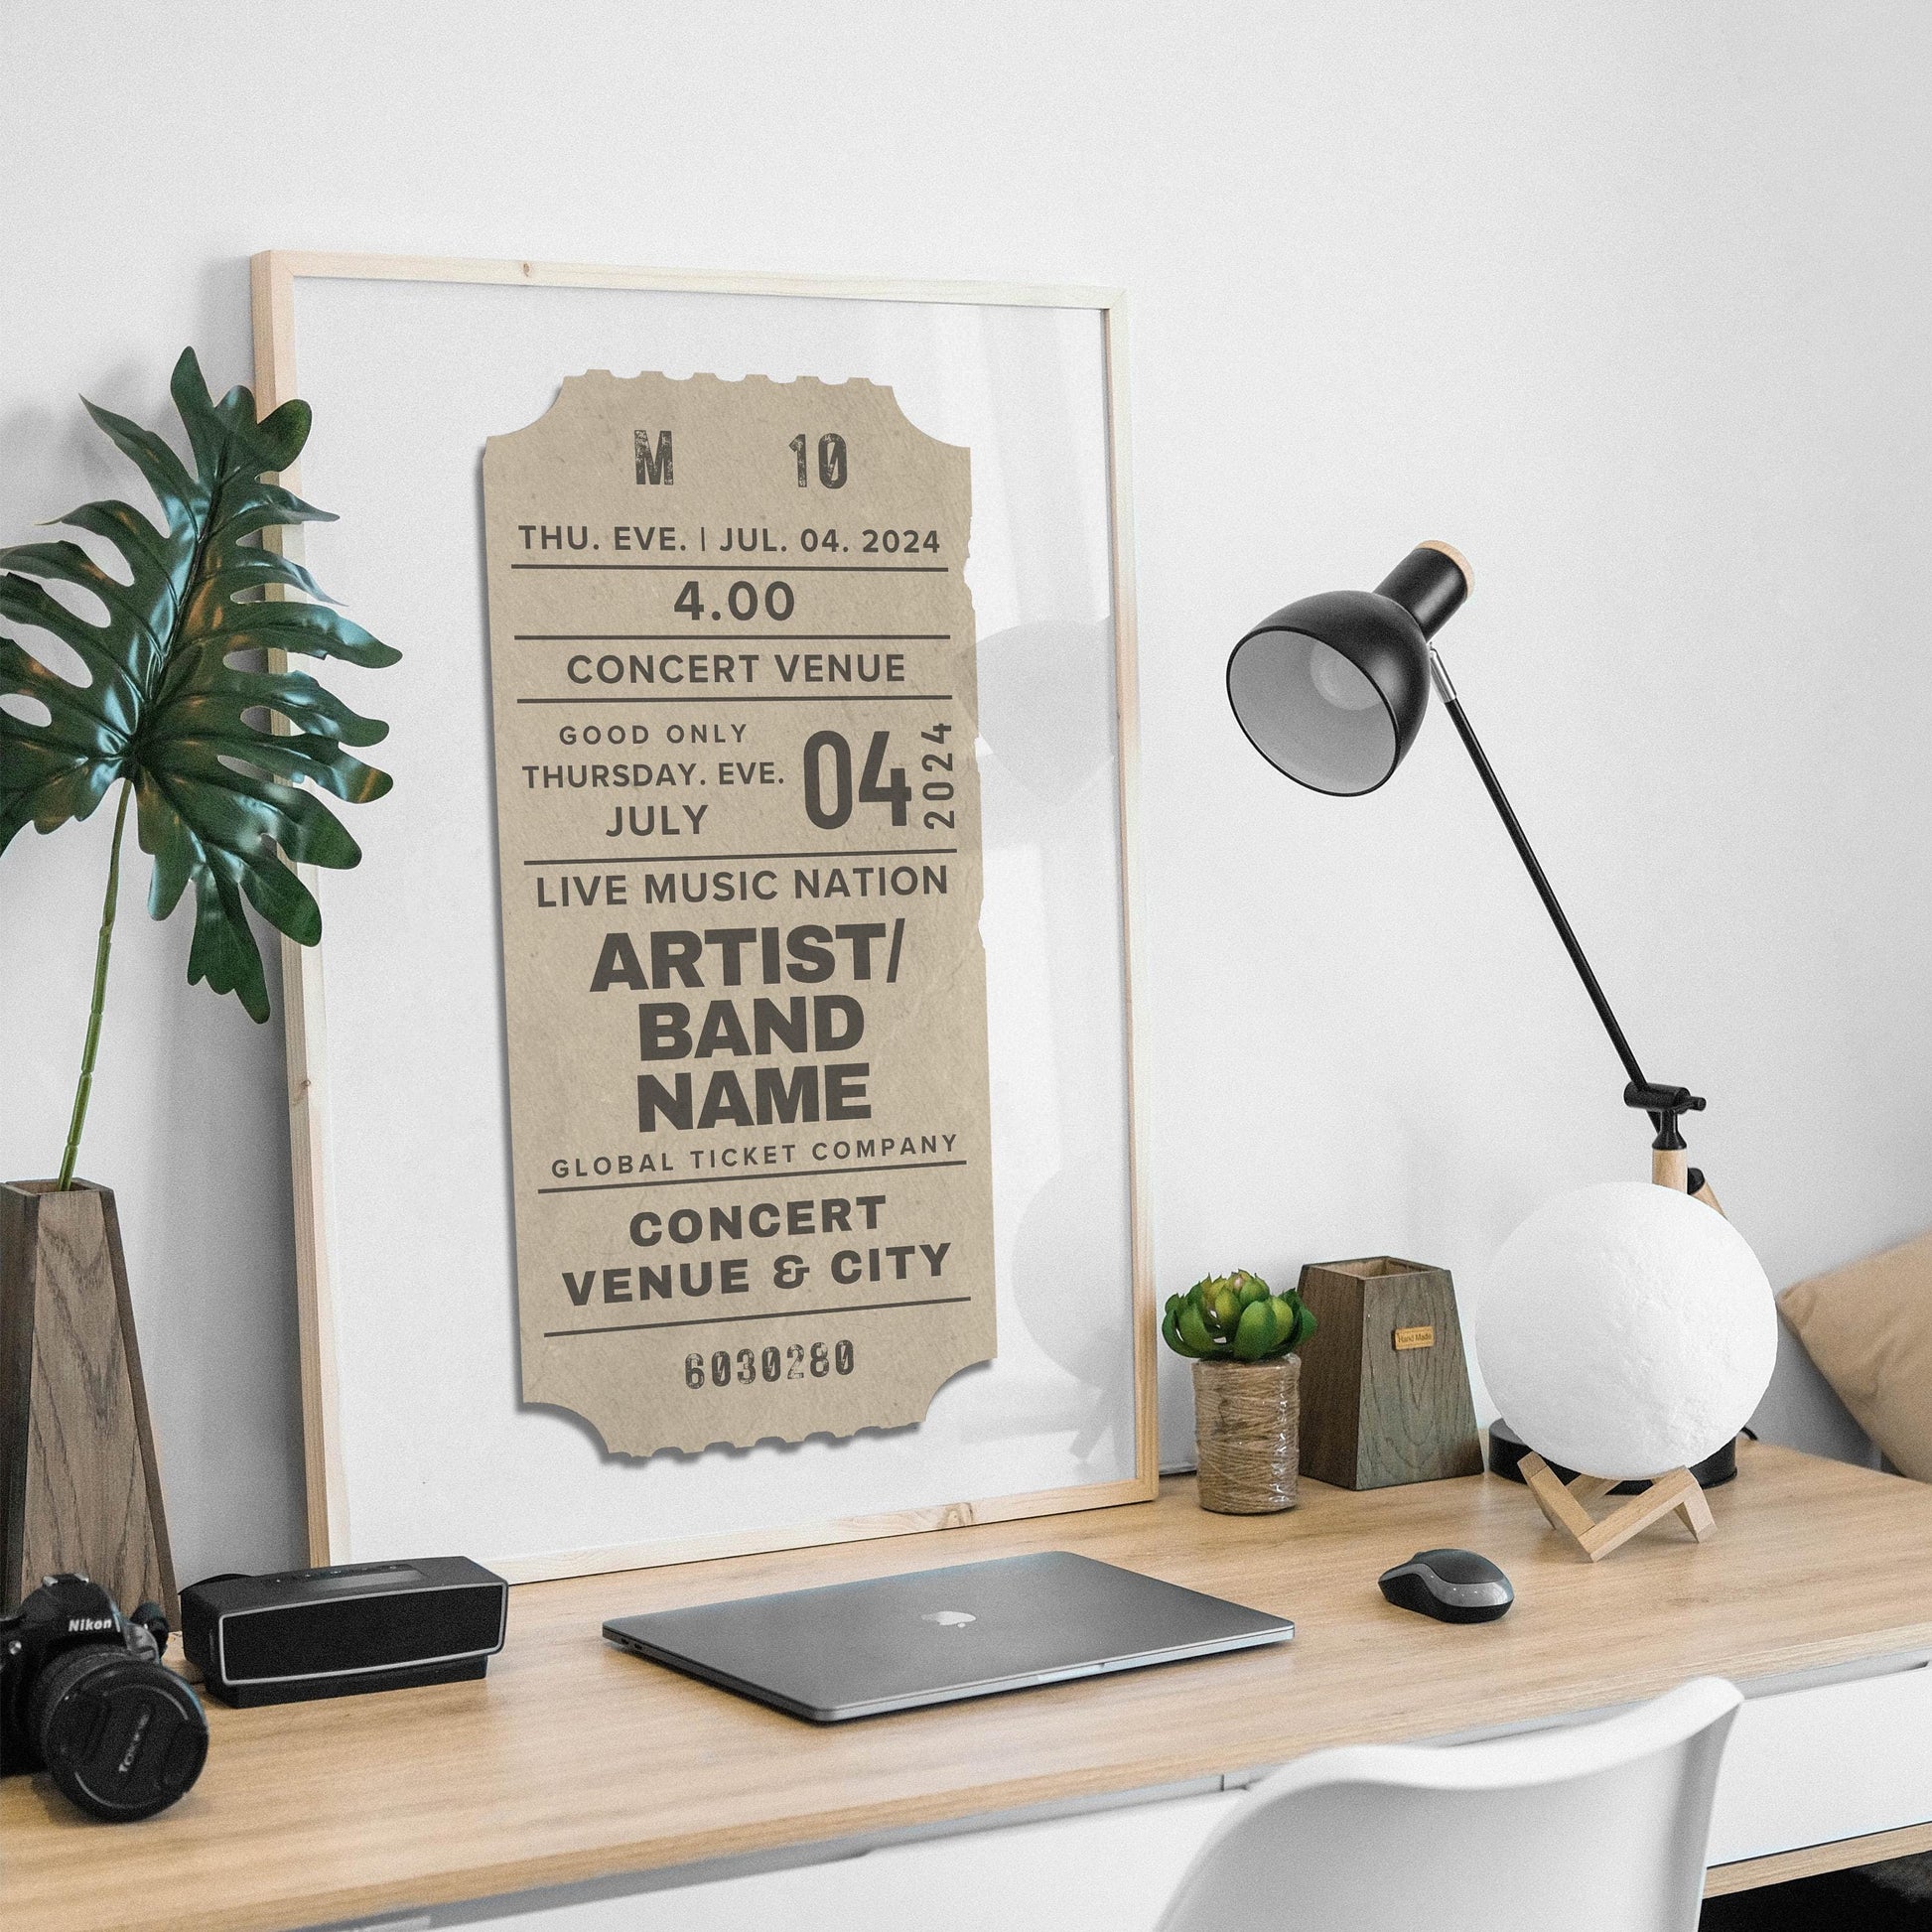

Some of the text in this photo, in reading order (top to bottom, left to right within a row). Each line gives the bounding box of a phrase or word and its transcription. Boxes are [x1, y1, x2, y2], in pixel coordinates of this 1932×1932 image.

[633, 429, 848, 489] M 10
[517, 524, 600, 551] THU.
[614, 526, 686, 552] EVE.
[719, 527, 787, 553] JUL.
[800, 527, 849, 553] 04.
[862, 528, 940, 554] 2024
[673, 580, 795, 621] 4.00
[567, 653, 905, 685] CONCERT VENUE
[559, 723, 747, 746] GOOD ONLY
[521, 761, 784, 789] THURSDAY. EVE.
[803, 730, 912, 830] 04
[920, 723, 955, 830] 2024
[605, 804, 709, 838] JULY
[536, 865, 947, 908] LIVE MUSIC NATION
[589, 917, 906, 993] ARTIST/
[638, 994, 865, 1062] BAND
[637, 1062, 872, 1133] NAME
[551, 1134, 958, 1179] GLOBAL TICKET COMPANY
[629, 1194, 887, 1248] CONCERT
[561, 1242, 952, 1307] VENUE & CITY
[684, 1339, 855, 1390] 6030280
[69, 1618, 111, 1631] Nikon
